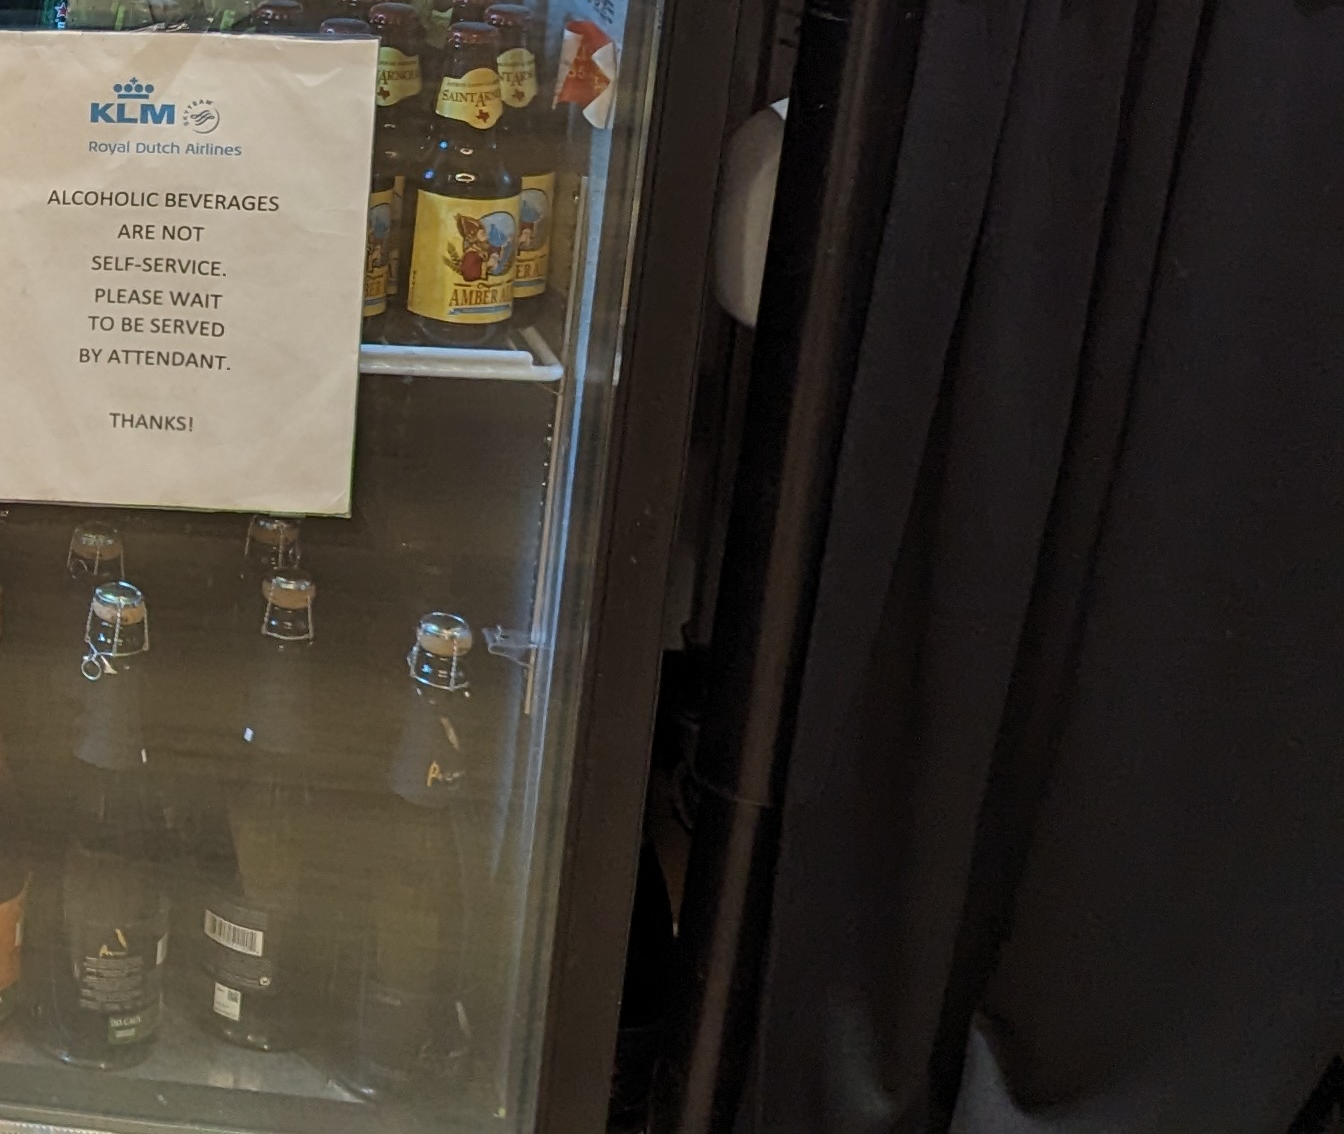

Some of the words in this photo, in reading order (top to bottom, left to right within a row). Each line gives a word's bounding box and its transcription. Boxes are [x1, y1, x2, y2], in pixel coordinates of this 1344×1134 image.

[442, 88, 475, 103] SAINT
[90, 102, 175, 125] KLM
[183, 99, 212, 127] SKYTEAM
[88, 141, 130, 155] Royal
[135, 142, 180, 154] Dutch
[185, 143, 242, 156] Airlines
[47, 189, 159, 208] ALCOHOLIC
[165, 193, 279, 212] BEVERAGES
[117, 224, 155, 241] ARE
[162, 226, 204, 242] NOT
[91, 255, 227, 277] SELF-SERVICE.
[94, 288, 163, 306] PLEASE
[169, 291, 223, 309] WAIT
[449, 287, 497, 307] AMBER
[88, 316, 114, 332] TO
[121, 317, 144, 333] BE
[150, 318, 225, 338] SERVED
[78, 348, 102, 364] BY
[107, 349, 231, 370] ATTENDANT.
[109, 412, 194, 432] THANKS!
